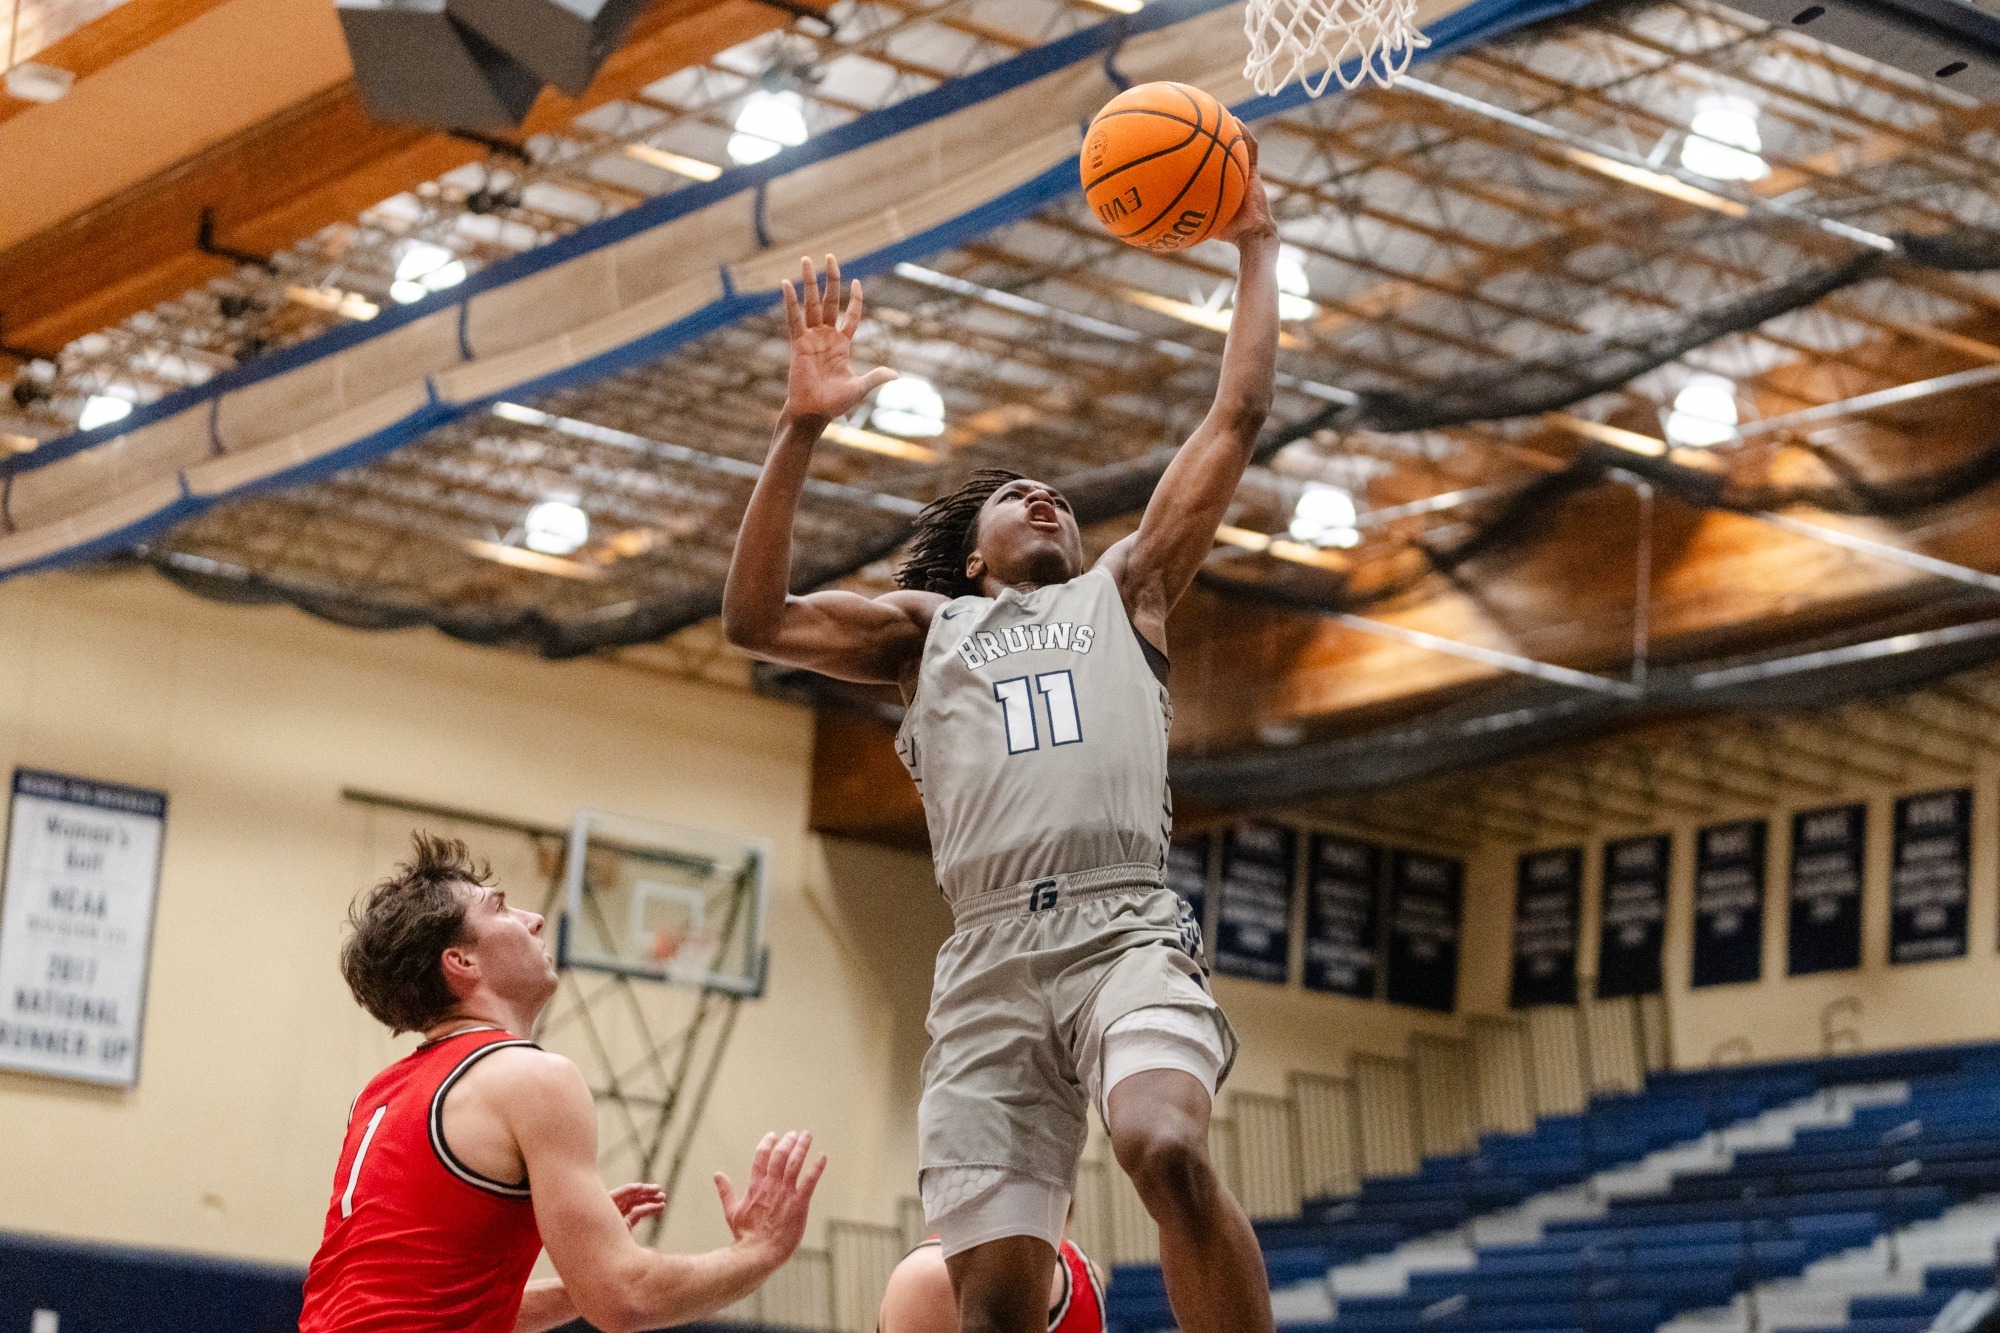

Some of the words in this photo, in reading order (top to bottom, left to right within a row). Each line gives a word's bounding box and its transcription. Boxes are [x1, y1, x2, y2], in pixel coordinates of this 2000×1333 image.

[957, 621, 1096, 671] BRUINS
[992, 669, 1084, 755] 11
[340, 1104, 387, 1220] 1
